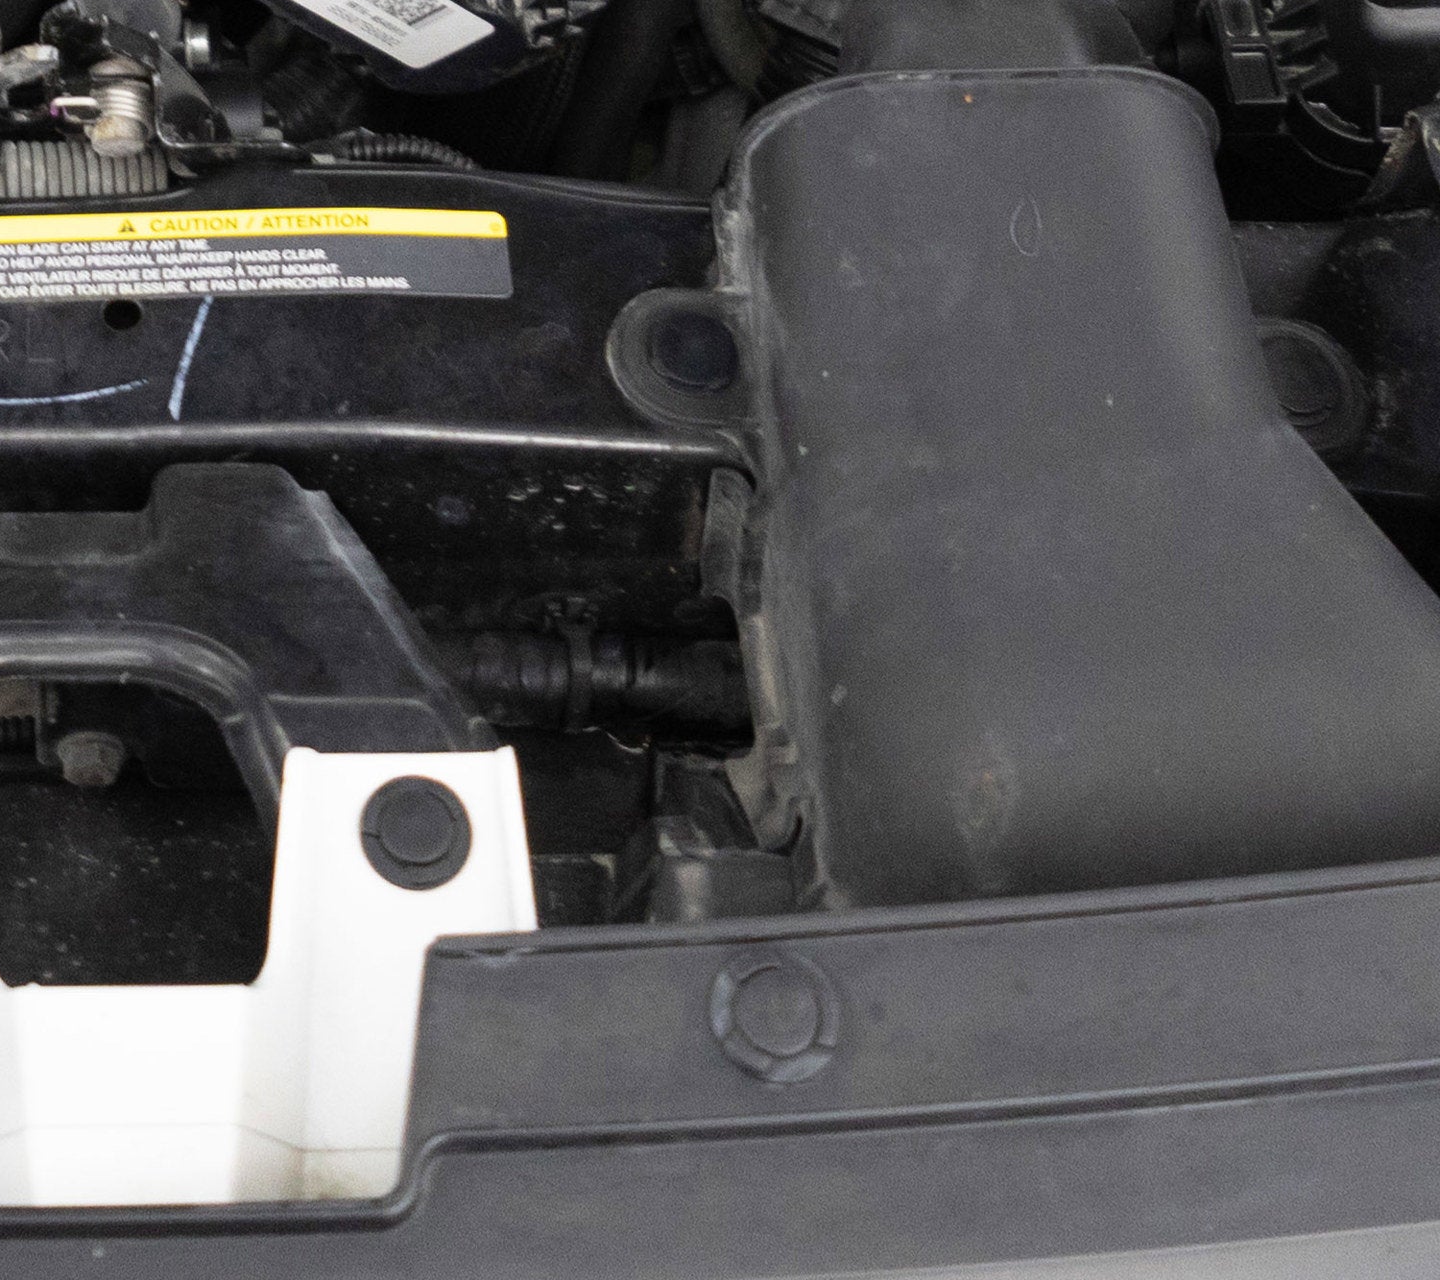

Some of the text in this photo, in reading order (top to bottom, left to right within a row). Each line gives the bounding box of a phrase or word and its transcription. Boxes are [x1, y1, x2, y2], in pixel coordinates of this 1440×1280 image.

[150, 217, 238, 233] CAUTION
[261, 214, 369, 231] ATTENTION
[16, 243, 59, 256] BLADE
[59, 242, 89, 255] CAN
[90, 241, 130, 253] START
[131, 240, 148, 252] AT
[148, 239, 177, 251] ANY
[9, 256, 45, 270] HELP
[45, 255, 85, 269] AVOID
[85, 253, 154, 267] PERSONAL
[235, 249, 281, 263] HANDS
[8, 269, 91, 285] VENTILATEUR
[91, 268, 141, 282] RISQUE
[141, 267, 161, 281] DE
[246, 263, 281, 277] TOUT
[75, 282, 118, 296] TOUTE
[189, 280, 210, 293] NE
[210, 279, 237, 292] PAS
[237, 278, 258, 291] EN
[258, 276, 340, 291] APPROCHER
[340, 277, 366, 289] LES
